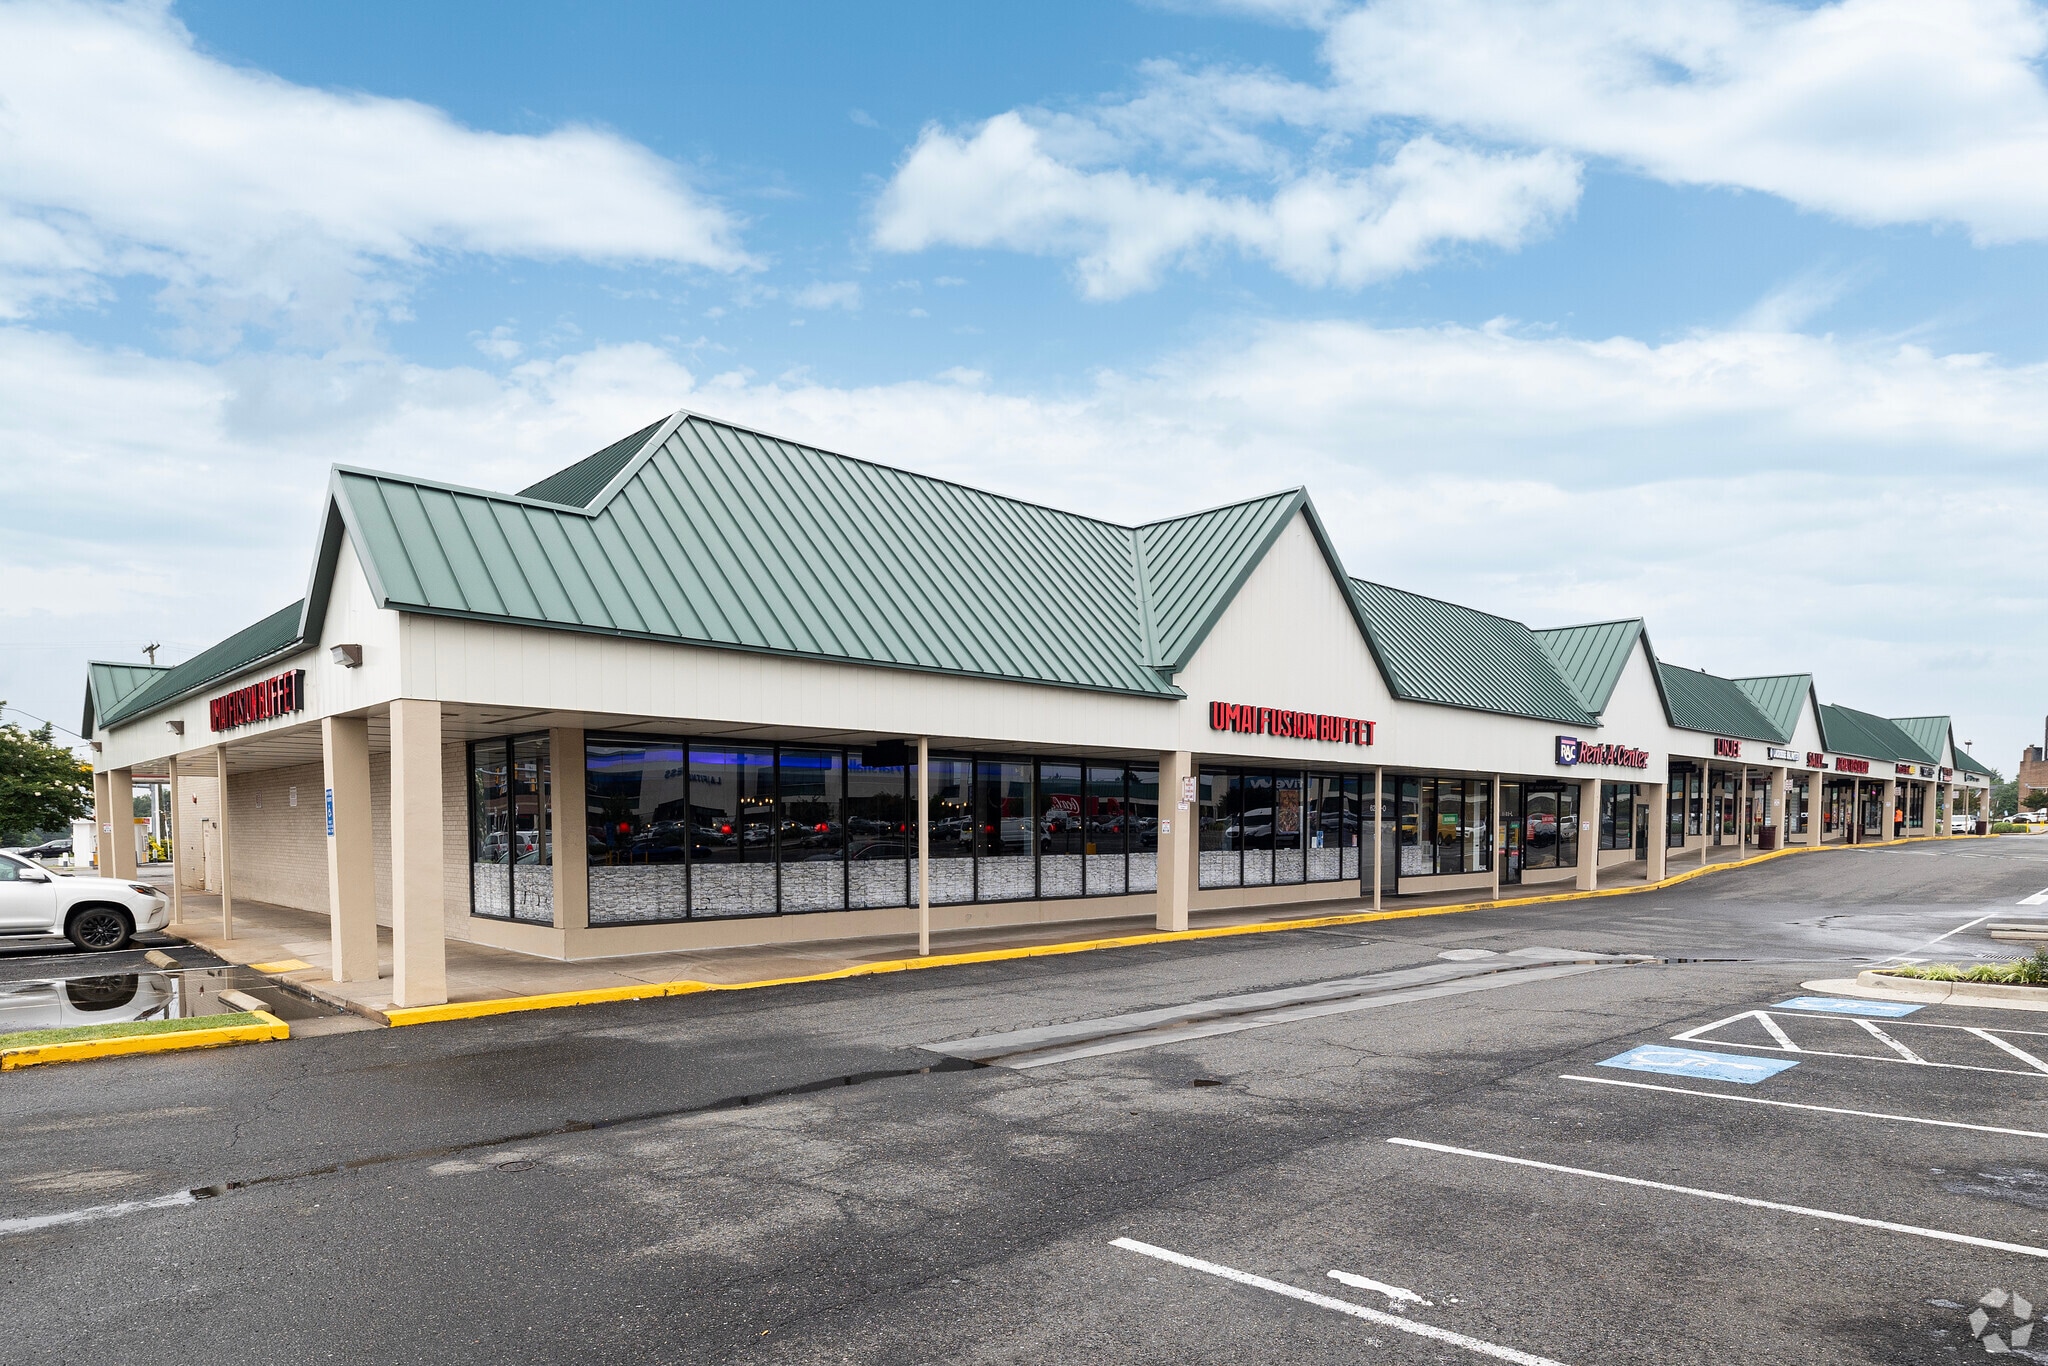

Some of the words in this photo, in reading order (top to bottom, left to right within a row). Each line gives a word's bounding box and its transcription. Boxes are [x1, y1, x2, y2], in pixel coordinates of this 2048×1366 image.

[257, 669, 303, 719] BUFFET
[1210, 701, 1256, 734] UMAI
[1257, 707, 1316, 739] FUSION
[1317, 715, 1376, 746] BUFFET
[1561, 744, 1576, 762] RAC
